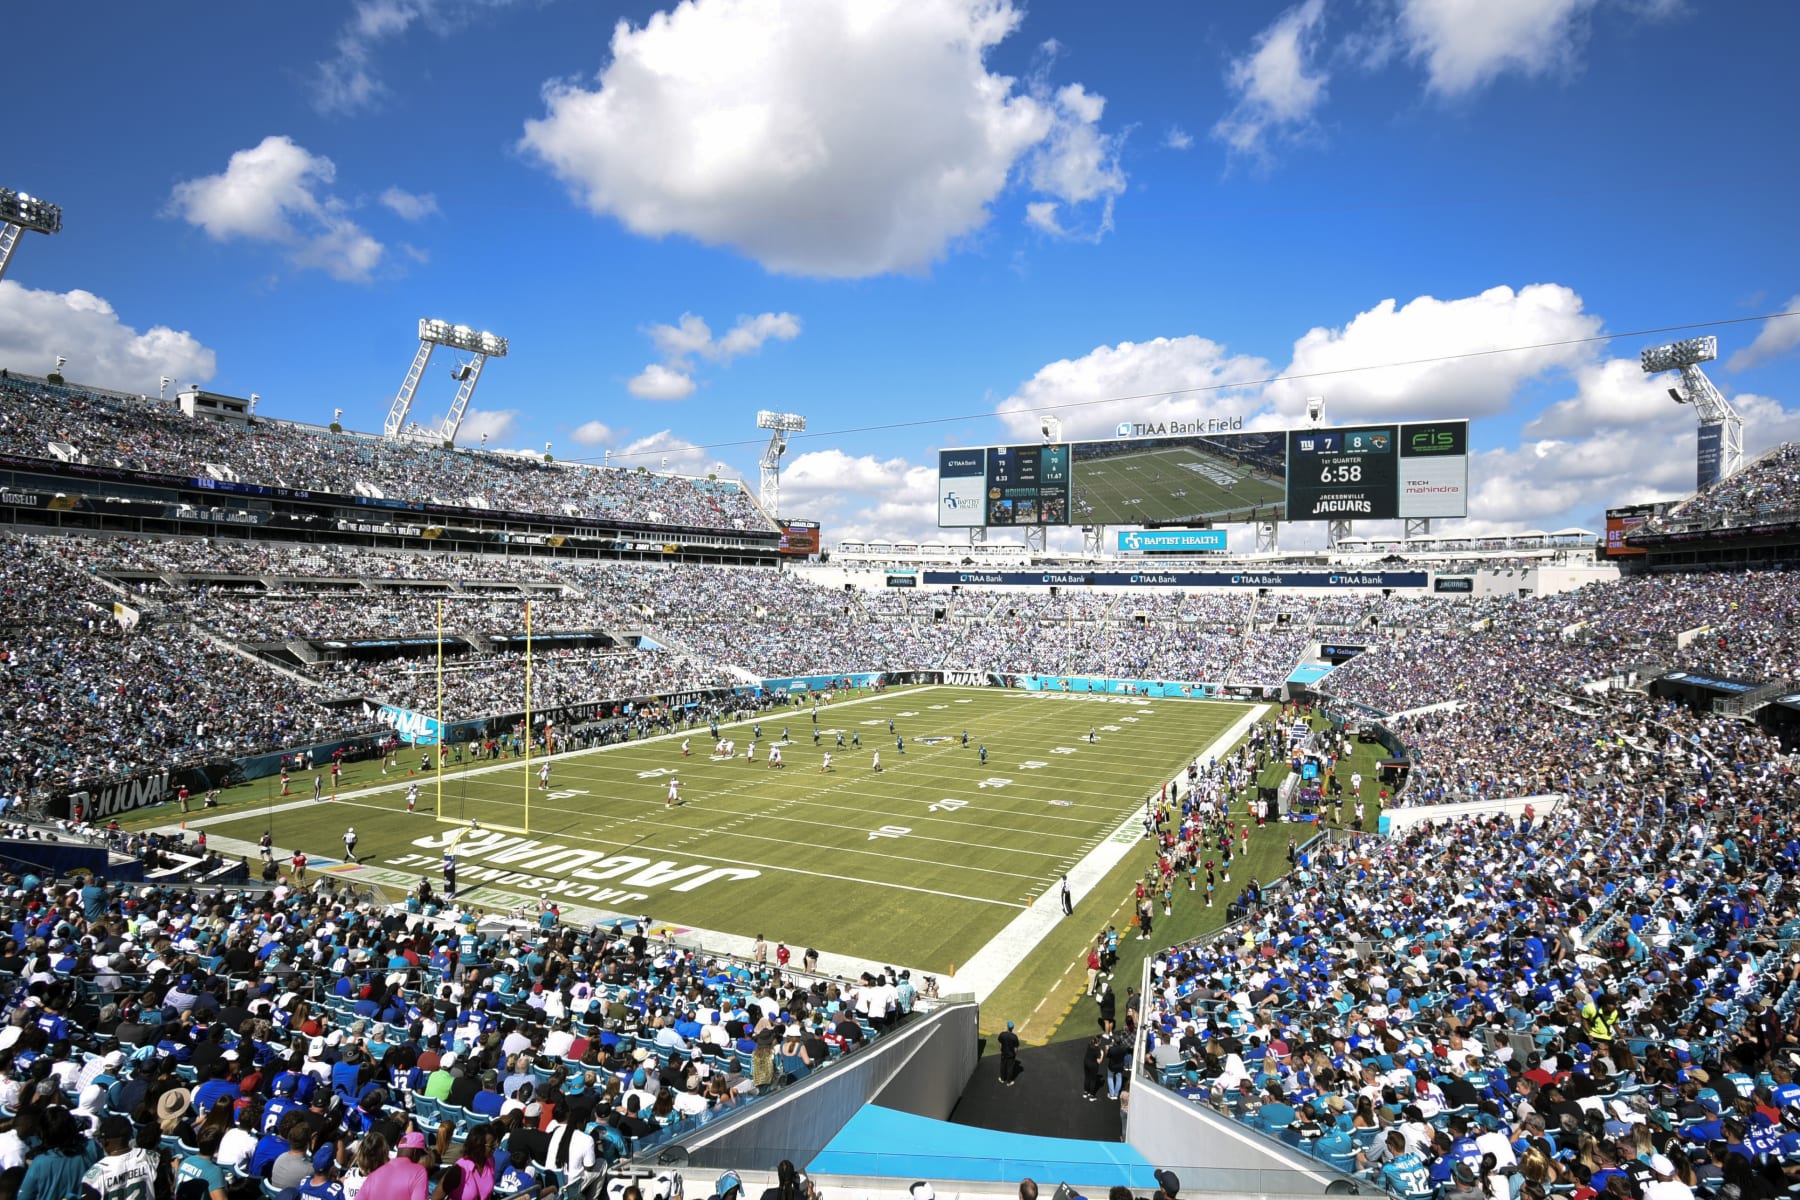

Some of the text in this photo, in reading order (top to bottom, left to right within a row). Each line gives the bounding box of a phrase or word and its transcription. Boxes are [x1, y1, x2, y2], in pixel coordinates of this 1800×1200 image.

[1133, 415, 1242, 436] TIAA Bank Field
[1324, 438, 1332, 449] 7
[1353, 436, 1362, 448] 8
[1412, 432, 1453, 445] FIS
[1320, 465, 1362, 483] 6:58
[294, 490, 309, 498] 6:58
[1406, 486, 1459, 494] mahindra
[1312, 500, 1372, 514] JAGUARS
[201, 512, 208, 520] OF
[212, 511, 224, 521] THE
[1144, 536, 1218, 545] BAPTIST HEALTH
[1609, 530, 1623, 540] GE
[967, 574, 1002, 583] TIAA Bank
[1050, 575, 1085, 583] TIAA Bank
[1138, 575, 1176, 584] TIAA Bank
[1240, 575, 1282, 584] TIAA Bank
[1338, 575, 1383, 584] TIAA Bank
[928, 798, 969, 812] 20
[867, 825, 912, 840] 10
[411, 826, 762, 892] JAGUARS
[384, 853, 649, 905] JACKSONVILLE
[462, 944, 472, 954] 16
[1400, 1166, 1430, 1196] 32
[326, 1182, 341, 1197] 10
